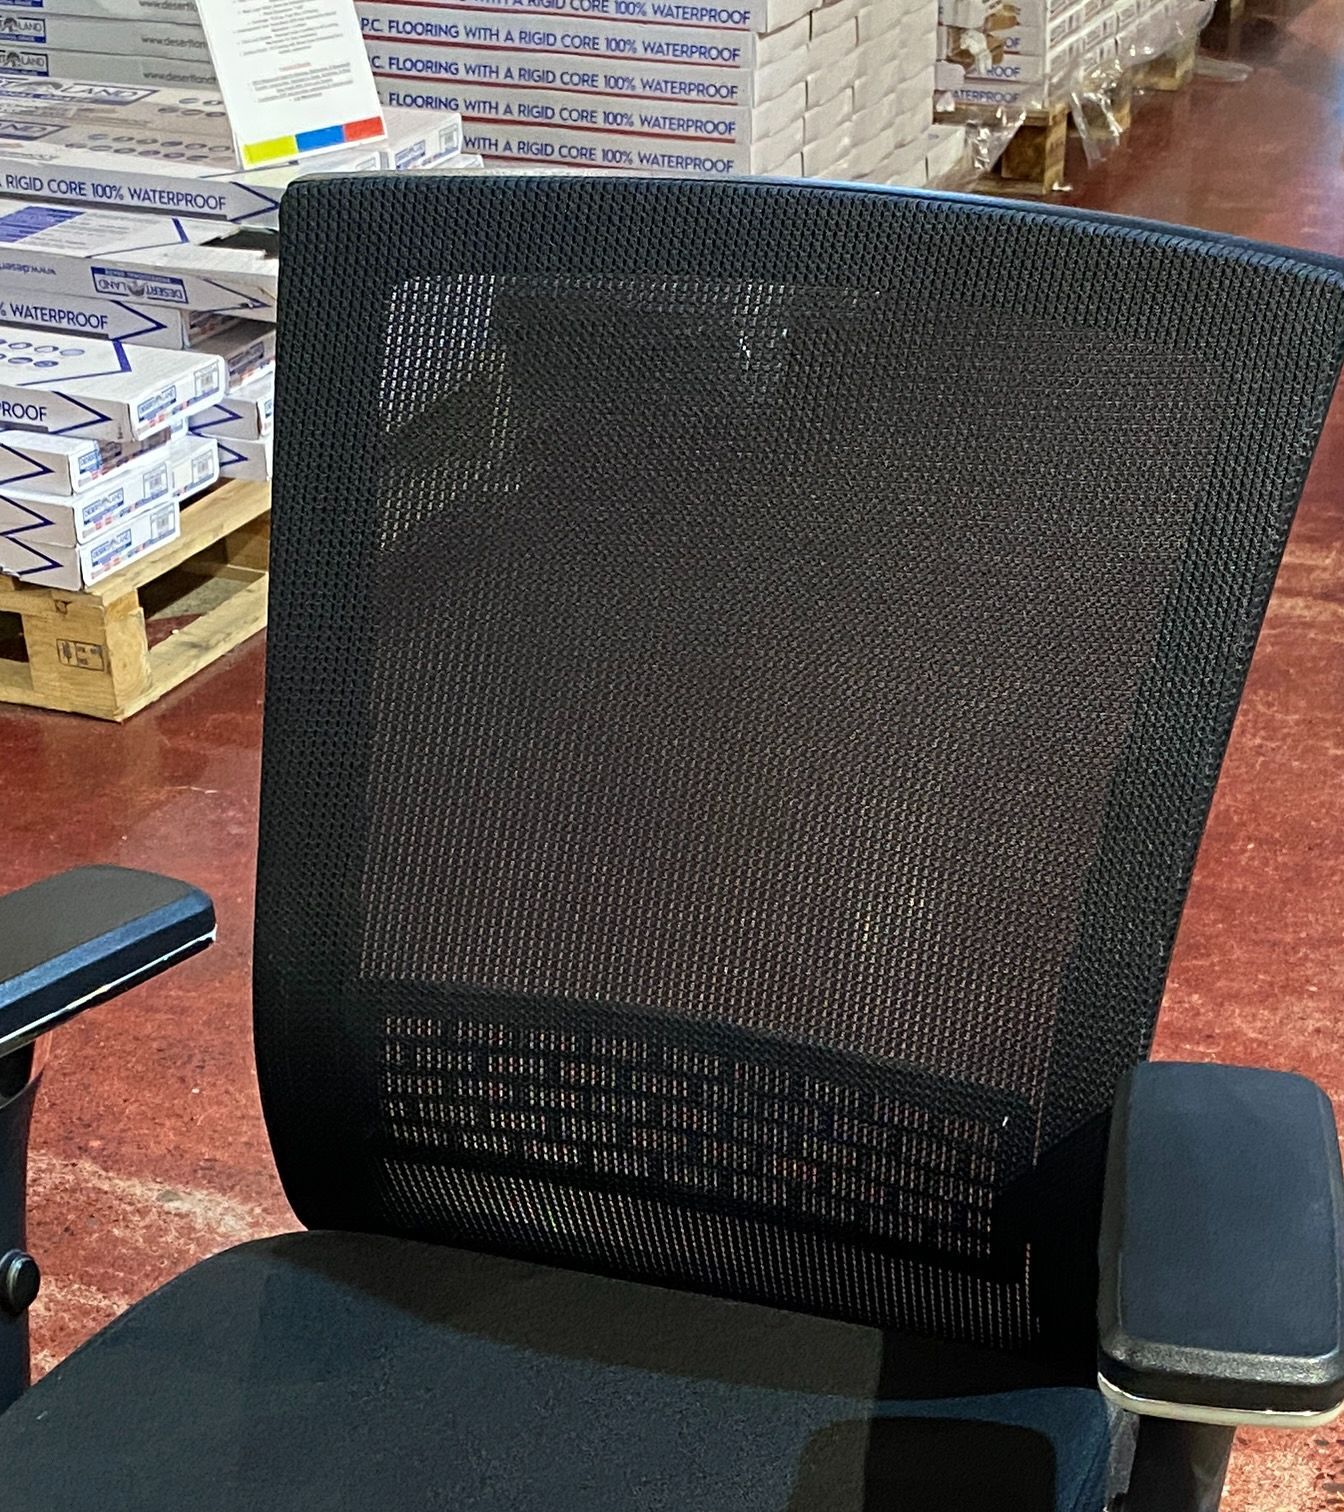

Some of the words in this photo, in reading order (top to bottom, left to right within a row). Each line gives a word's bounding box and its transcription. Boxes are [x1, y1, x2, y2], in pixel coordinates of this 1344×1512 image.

[570, 0, 609, 13] CORE
[615, 1, 647, 16] 100%
[651, 4, 750, 24] WATERPROOF
[388, 20, 459, 39] FLOORING
[463, 25, 499, 42] WITH
[504, 30, 514, 43] A
[518, 31, 557, 47] RIGID
[561, 34, 600, 51] CORE
[605, 37, 637, 54] 100%
[642, 40, 741, 62] WATERPROOF
[388, 57, 459, 76] FLOORING
[463, 63, 499, 79] WITH
[504, 68, 514, 81] A
[518, 68, 556, 84] RIGID
[560, 71, 599, 88] CORE
[604, 75, 636, 92] 100%
[640, 78, 738, 99] WATERPROOF
[389, 92, 459, 111] FLOORING
[463, 98, 499, 115] WITH
[503, 103, 513, 116] A
[518, 104, 555, 120] RIGID
[559, 107, 598, 124] CORE
[603, 111, 634, 128] 100%
[639, 114, 736, 136] WATERPROOF
[953, 90, 1020, 103] ATERPROOF
[463, 135, 499, 152] WITH
[502, 140, 513, 153] A
[517, 141, 554, 157] RIGID
[559, 145, 597, 162] CORE
[602, 149, 633, 165] 100%
[638, 151, 734, 173] WATERPROOF
[6, 175, 43, 192] RIGID
[47, 178, 87, 196] CORE
[91, 183, 124, 200] 100%
[128, 187, 227, 210] WATERPROOF
[10, 303, 108, 330] WATERPROOF
